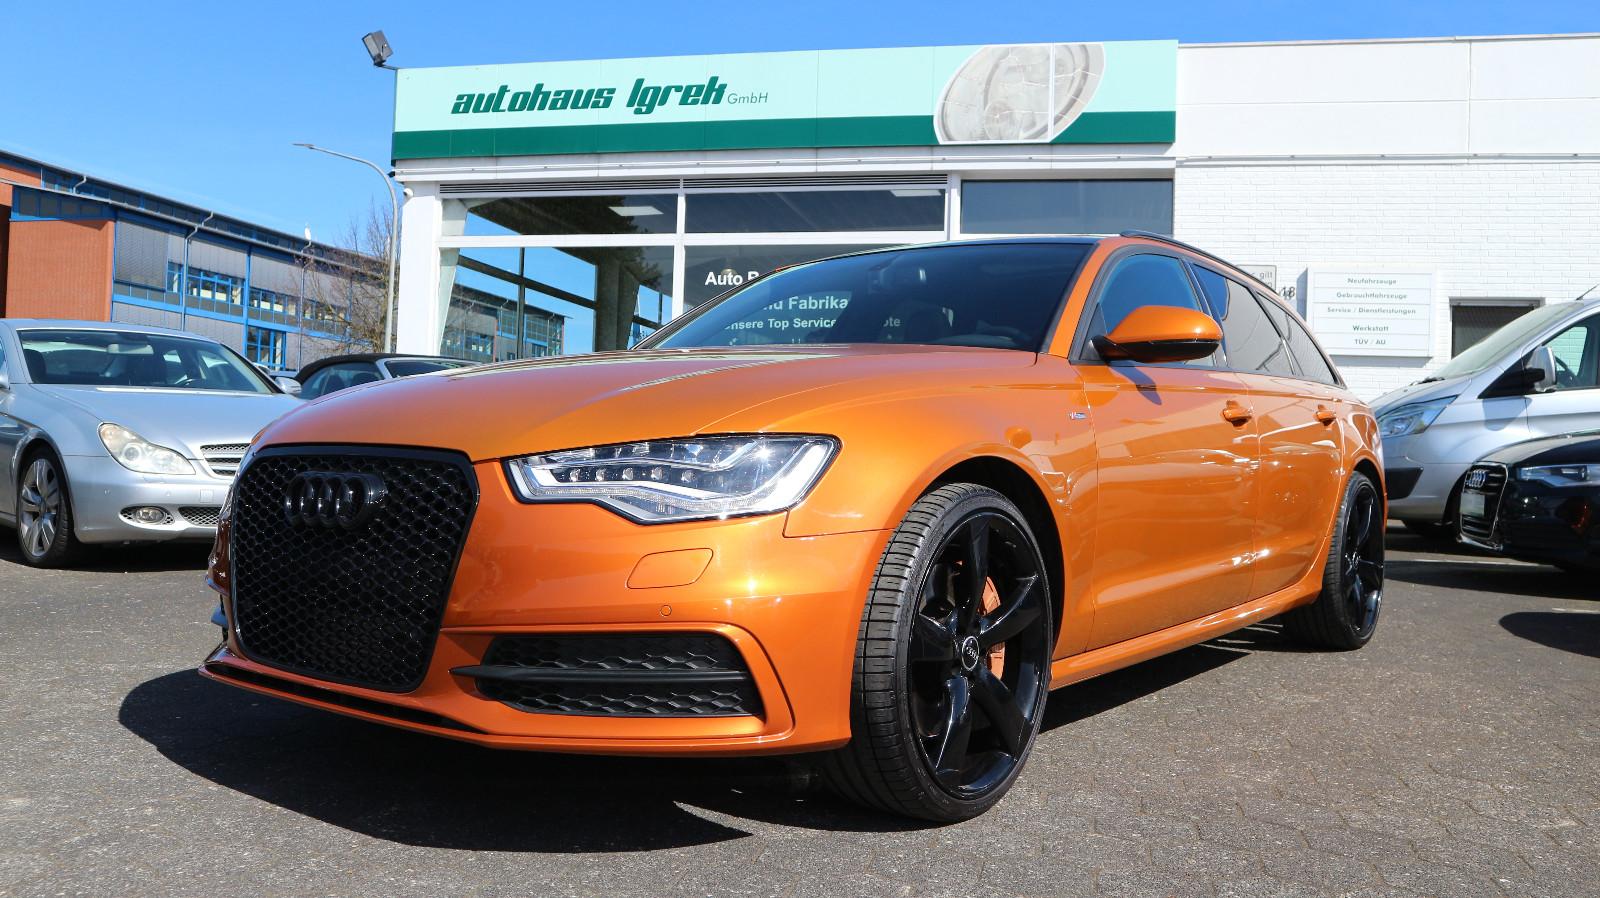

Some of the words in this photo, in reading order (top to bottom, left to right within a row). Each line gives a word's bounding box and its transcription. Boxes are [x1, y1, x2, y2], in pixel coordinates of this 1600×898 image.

[451, 83, 616, 114] autohaus
[727, 92, 769, 104] GmbH
[704, 271, 743, 286] Auto
[1358, 307, 1417, 315] Dienstleistungen
[725, 320, 764, 330] nsere
[767, 318, 789, 331] Top
